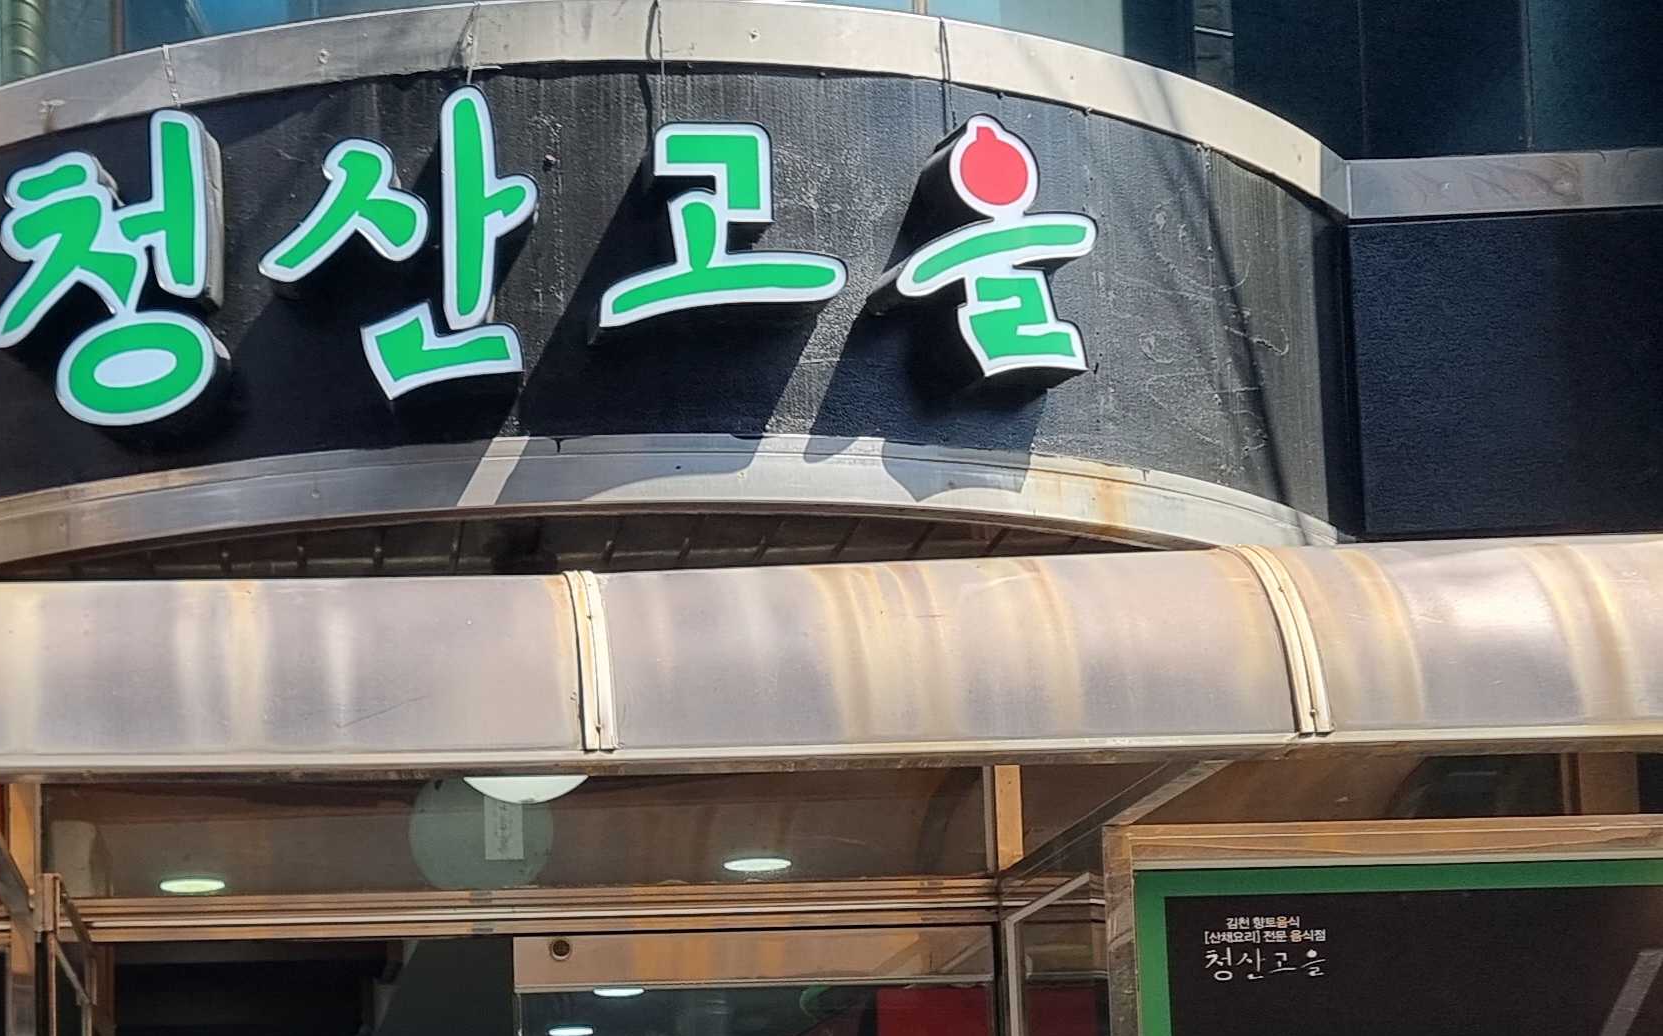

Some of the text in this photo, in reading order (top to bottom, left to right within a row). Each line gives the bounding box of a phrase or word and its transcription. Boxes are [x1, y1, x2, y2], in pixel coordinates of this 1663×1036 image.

[1226, 916, 1300, 929] 김천 향토음식
[1204, 929, 1326, 944] [산채요리] 전문 음식점
[1205, 946, 1326, 981] 청산고을
